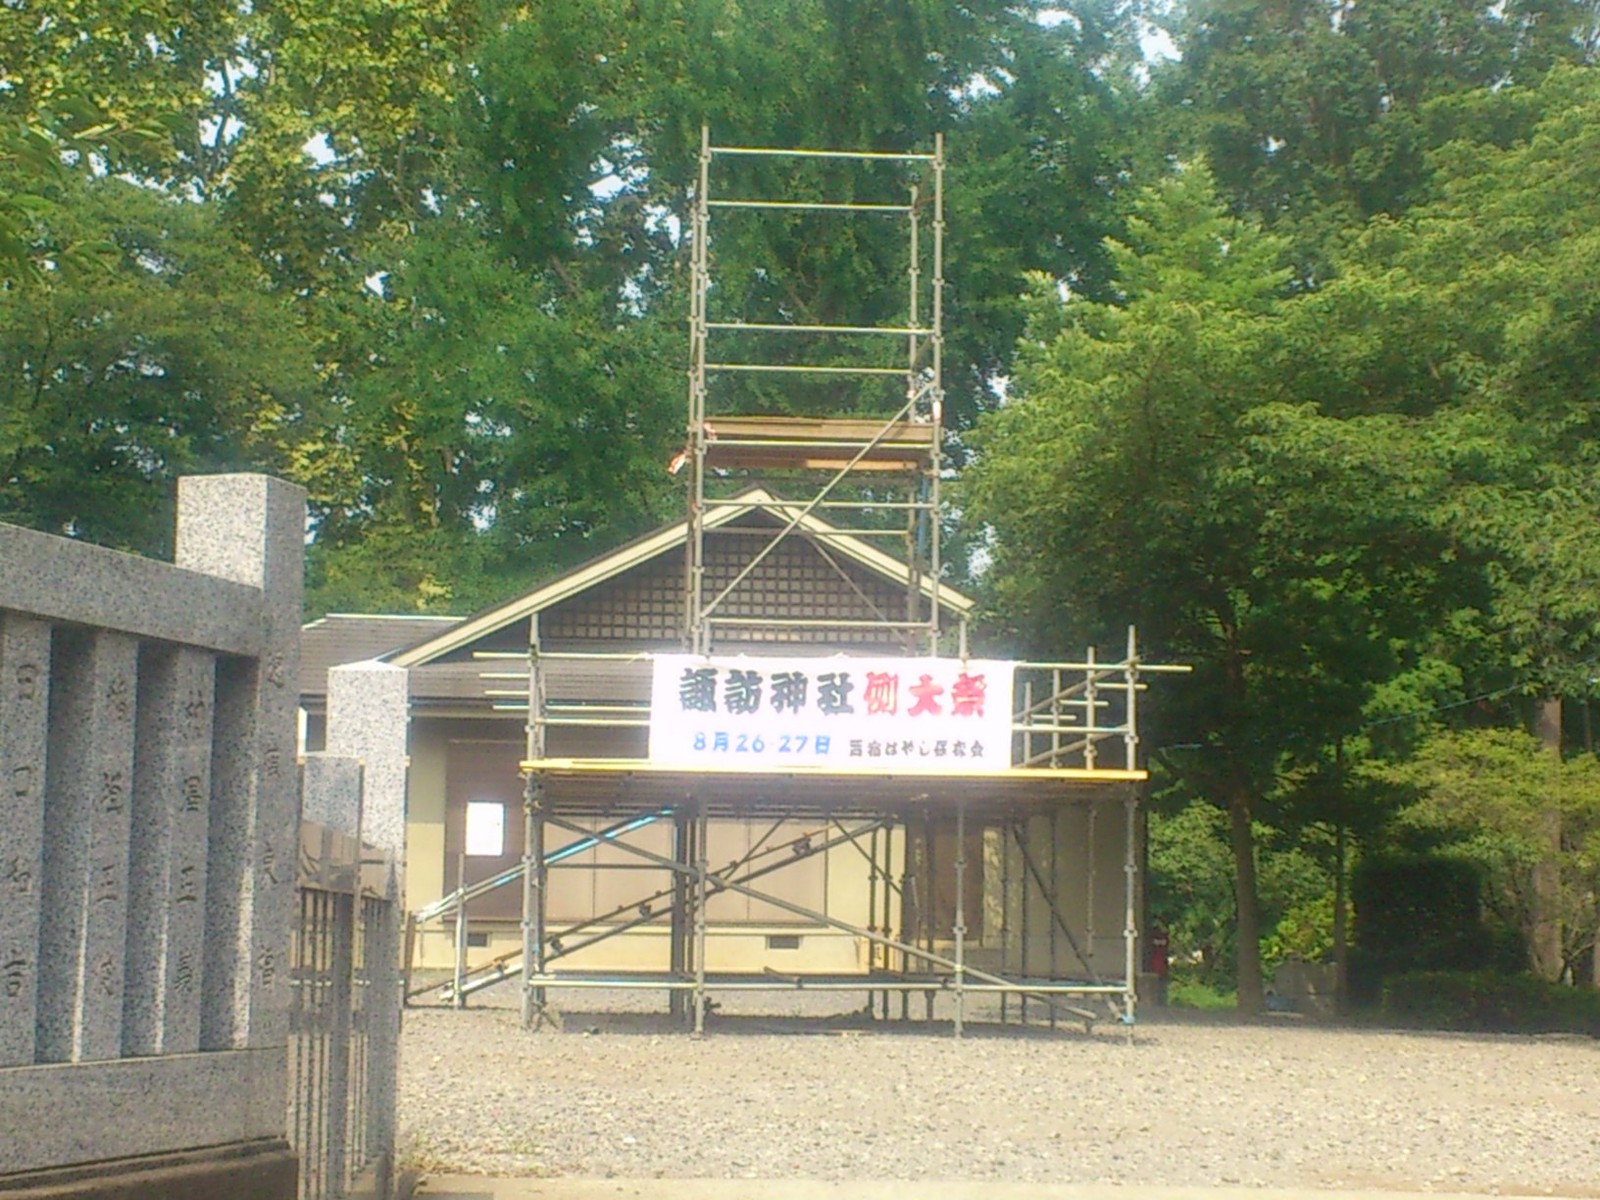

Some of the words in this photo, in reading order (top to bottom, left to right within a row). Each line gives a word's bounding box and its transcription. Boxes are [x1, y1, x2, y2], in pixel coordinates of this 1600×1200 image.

[679, 667, 987, 717] 諏訪神社例大祭
